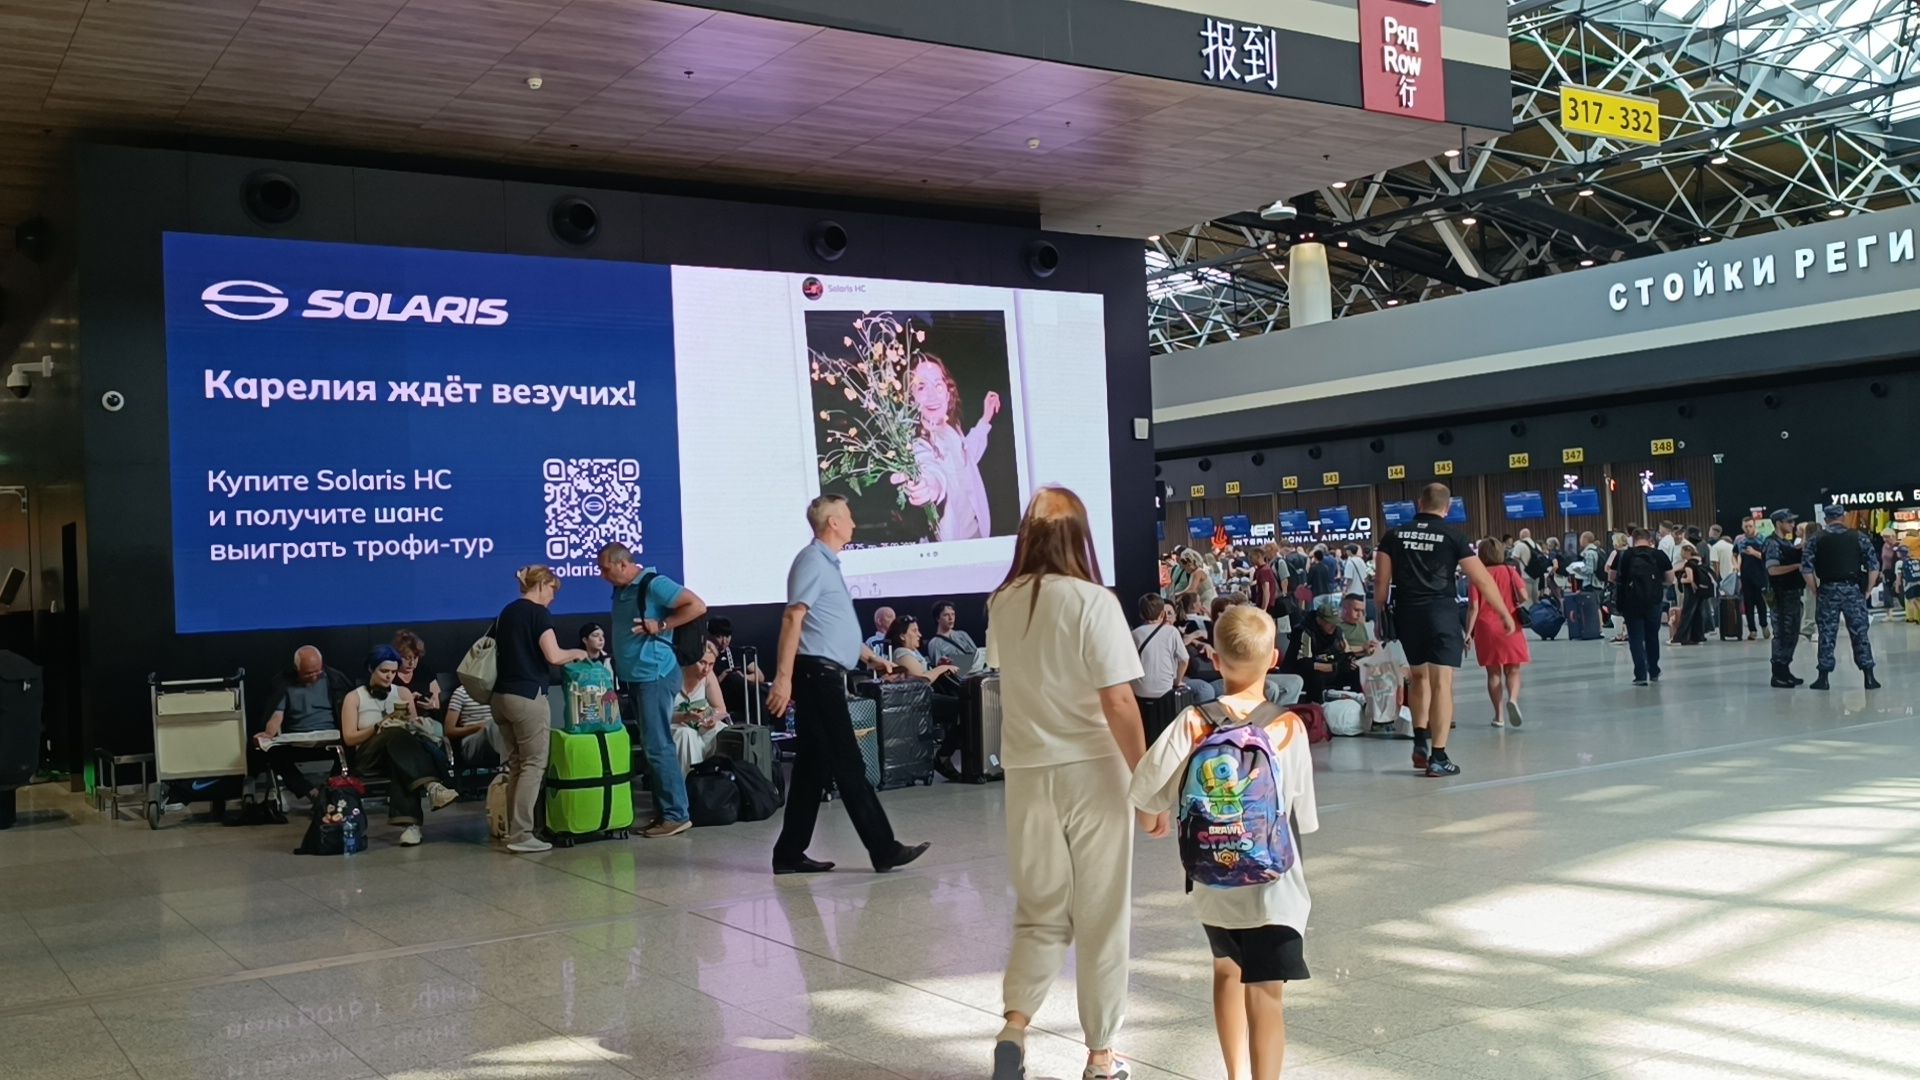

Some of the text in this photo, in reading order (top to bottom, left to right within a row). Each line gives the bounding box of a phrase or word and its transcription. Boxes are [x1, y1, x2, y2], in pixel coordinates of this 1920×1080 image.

[1383, 15, 1419, 53] Ряд
[1199, 18, 1279, 90] 报到
[1383, 44, 1422, 77] Row
[1399, 74, 1417, 108] 行
[1568, 97, 1603, 125] 317
[1619, 106, 1653, 134] 332
[1608, 228, 1915, 311] СТОЙКИ РЕГИ
[302, 289, 509, 326] SOLARIS
[204, 369, 637, 412] Карелия ждёт везучих!
[208, 470, 309, 498] Купите
[317, 468, 406, 491] Solaris
[1831, 490, 1904, 505] УПАКОВКА
[209, 506, 444, 530] и получите шанс
[210, 533, 495, 565] выиграть трофи-тур
[1321, 532, 1371, 541] AIRPORT
[1398, 531, 1444, 543] RUSSIAN
[1403, 541, 1434, 551] TEAM
